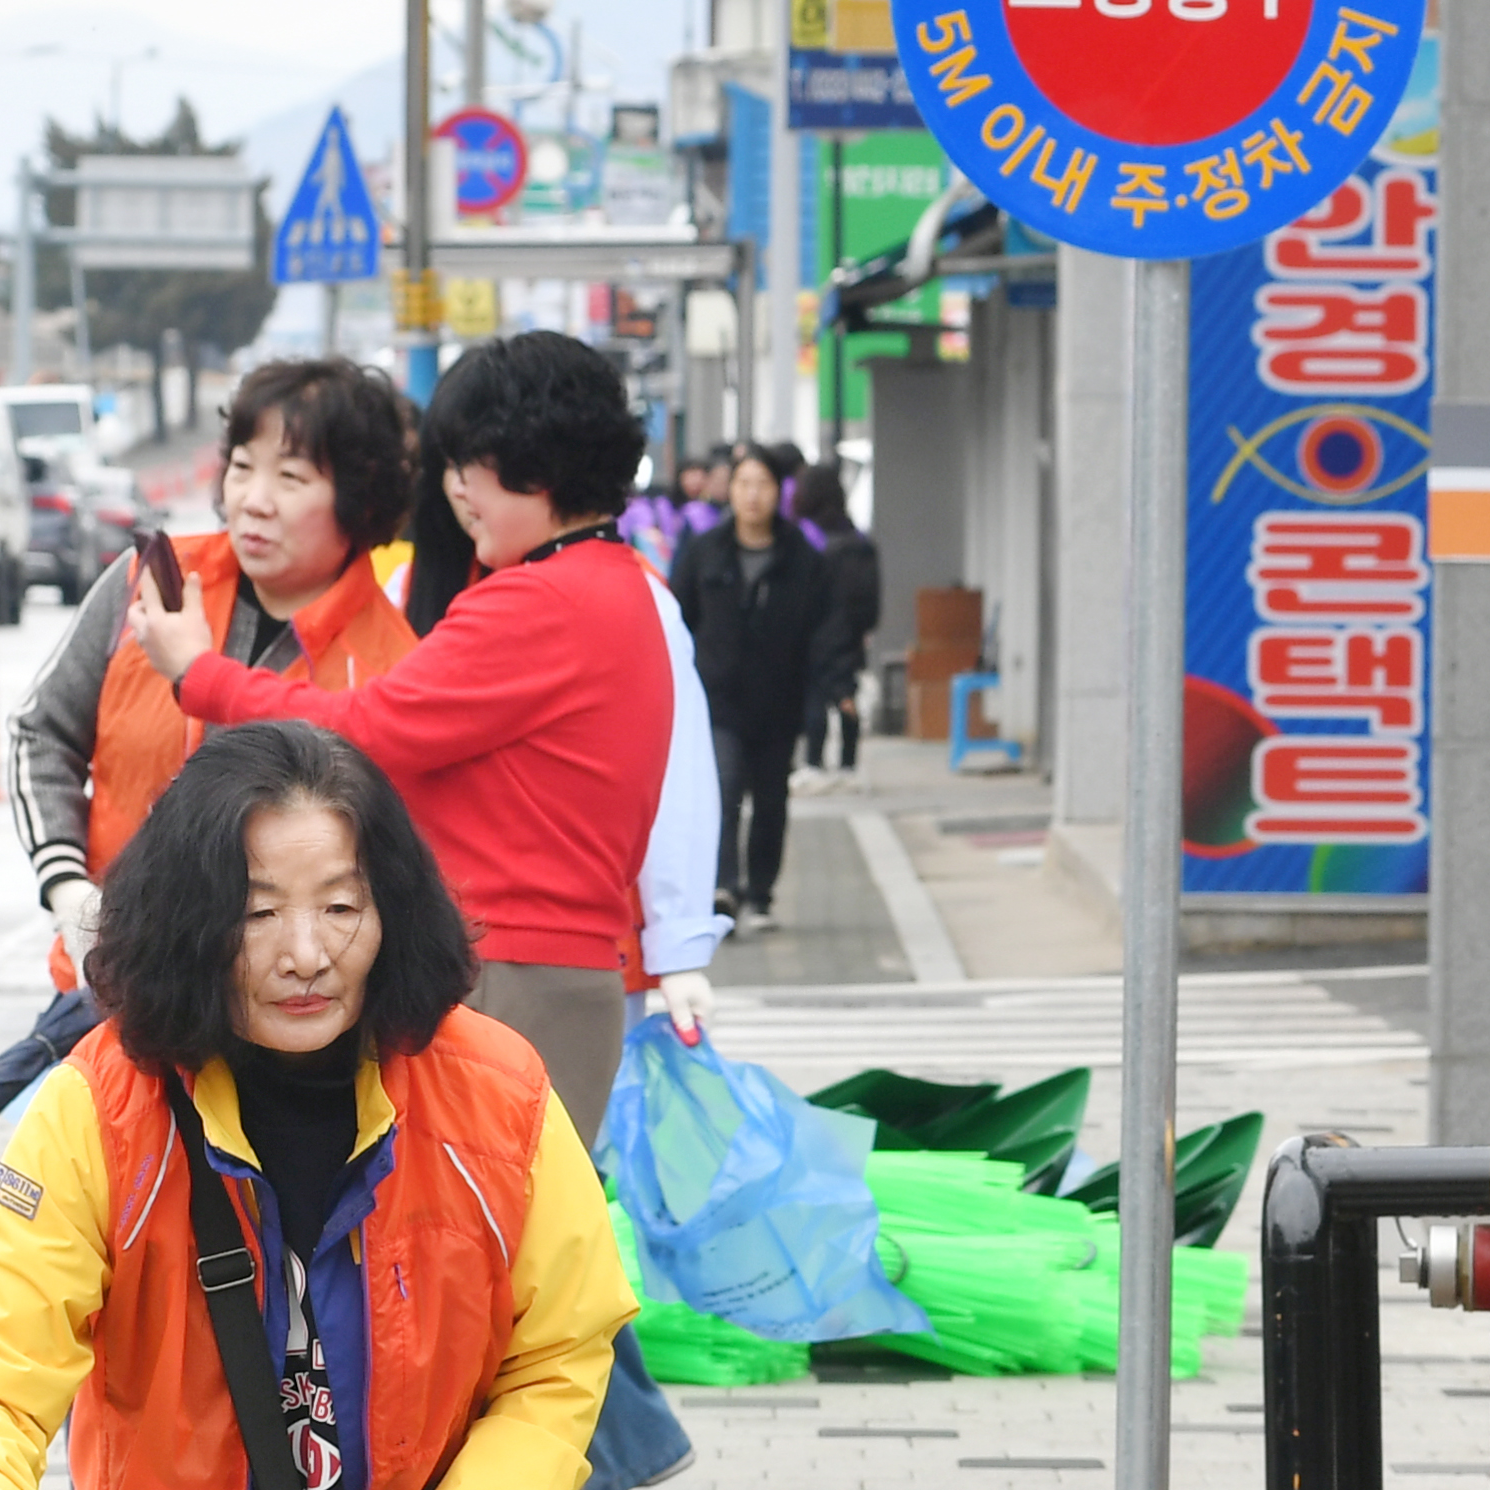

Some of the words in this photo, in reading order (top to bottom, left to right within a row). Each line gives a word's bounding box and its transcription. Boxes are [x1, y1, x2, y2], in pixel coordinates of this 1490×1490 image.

[916, 10, 993, 107] 5M
[980, 103, 1098, 214] 이내
[1298, 6, 1400, 137] 금지
[1249, 169, 1436, 397] 안경
[1245, 511, 1430, 846] 콘택트
